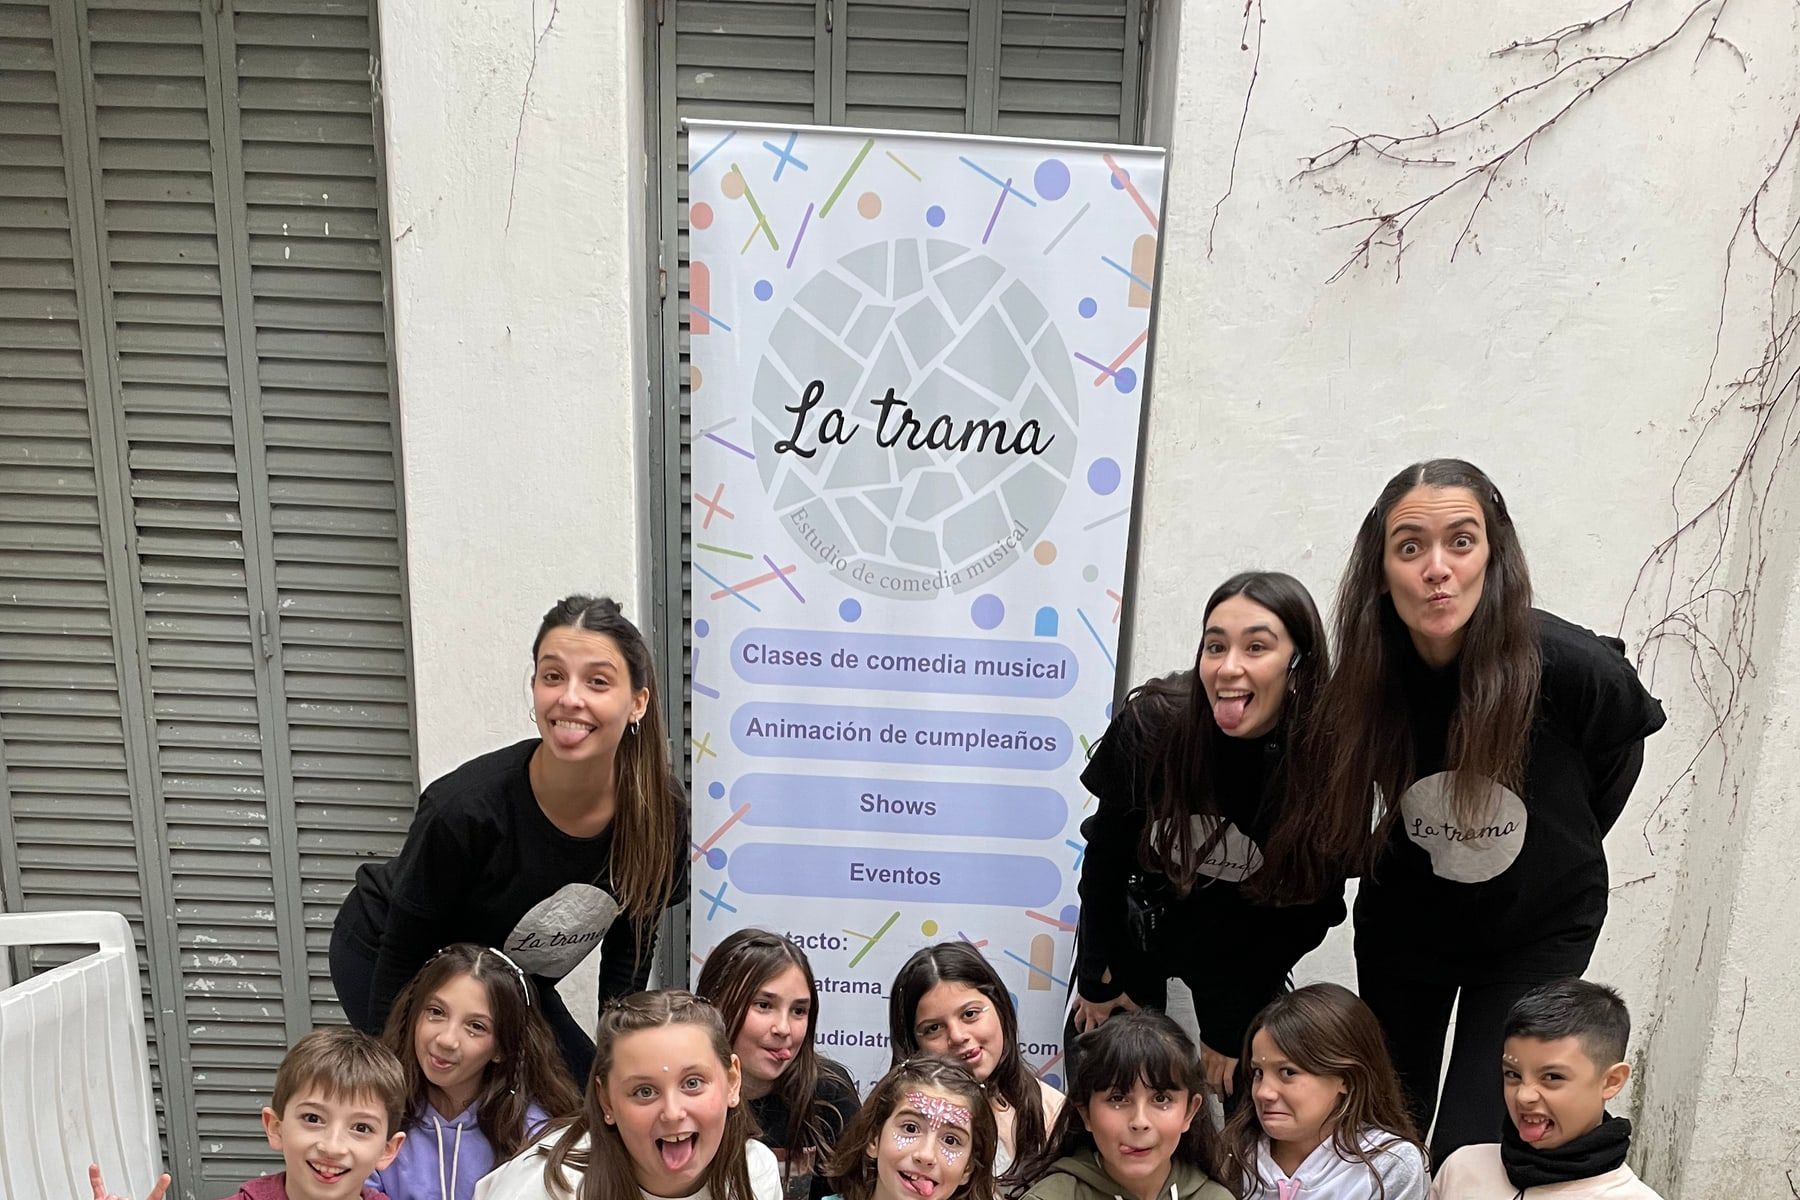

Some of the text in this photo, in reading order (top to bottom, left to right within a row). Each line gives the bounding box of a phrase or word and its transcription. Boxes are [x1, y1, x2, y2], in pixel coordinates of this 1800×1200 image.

[774, 379, 1056, 459] La trama
[790, 507, 1029, 592] Estudio de comedia musical
[742, 643, 1067, 680] Clases de comedia musical
[746, 717, 1057, 752] Animación de cumpleaños
[860, 792, 937, 816] Shows
[1411, 818, 1520, 842] La trama
[849, 863, 942, 886] Eventos
[511, 932, 545, 952] La
[785, 931, 848, 951] tacto:
[815, 1030, 1059, 1056] udiolatr com
